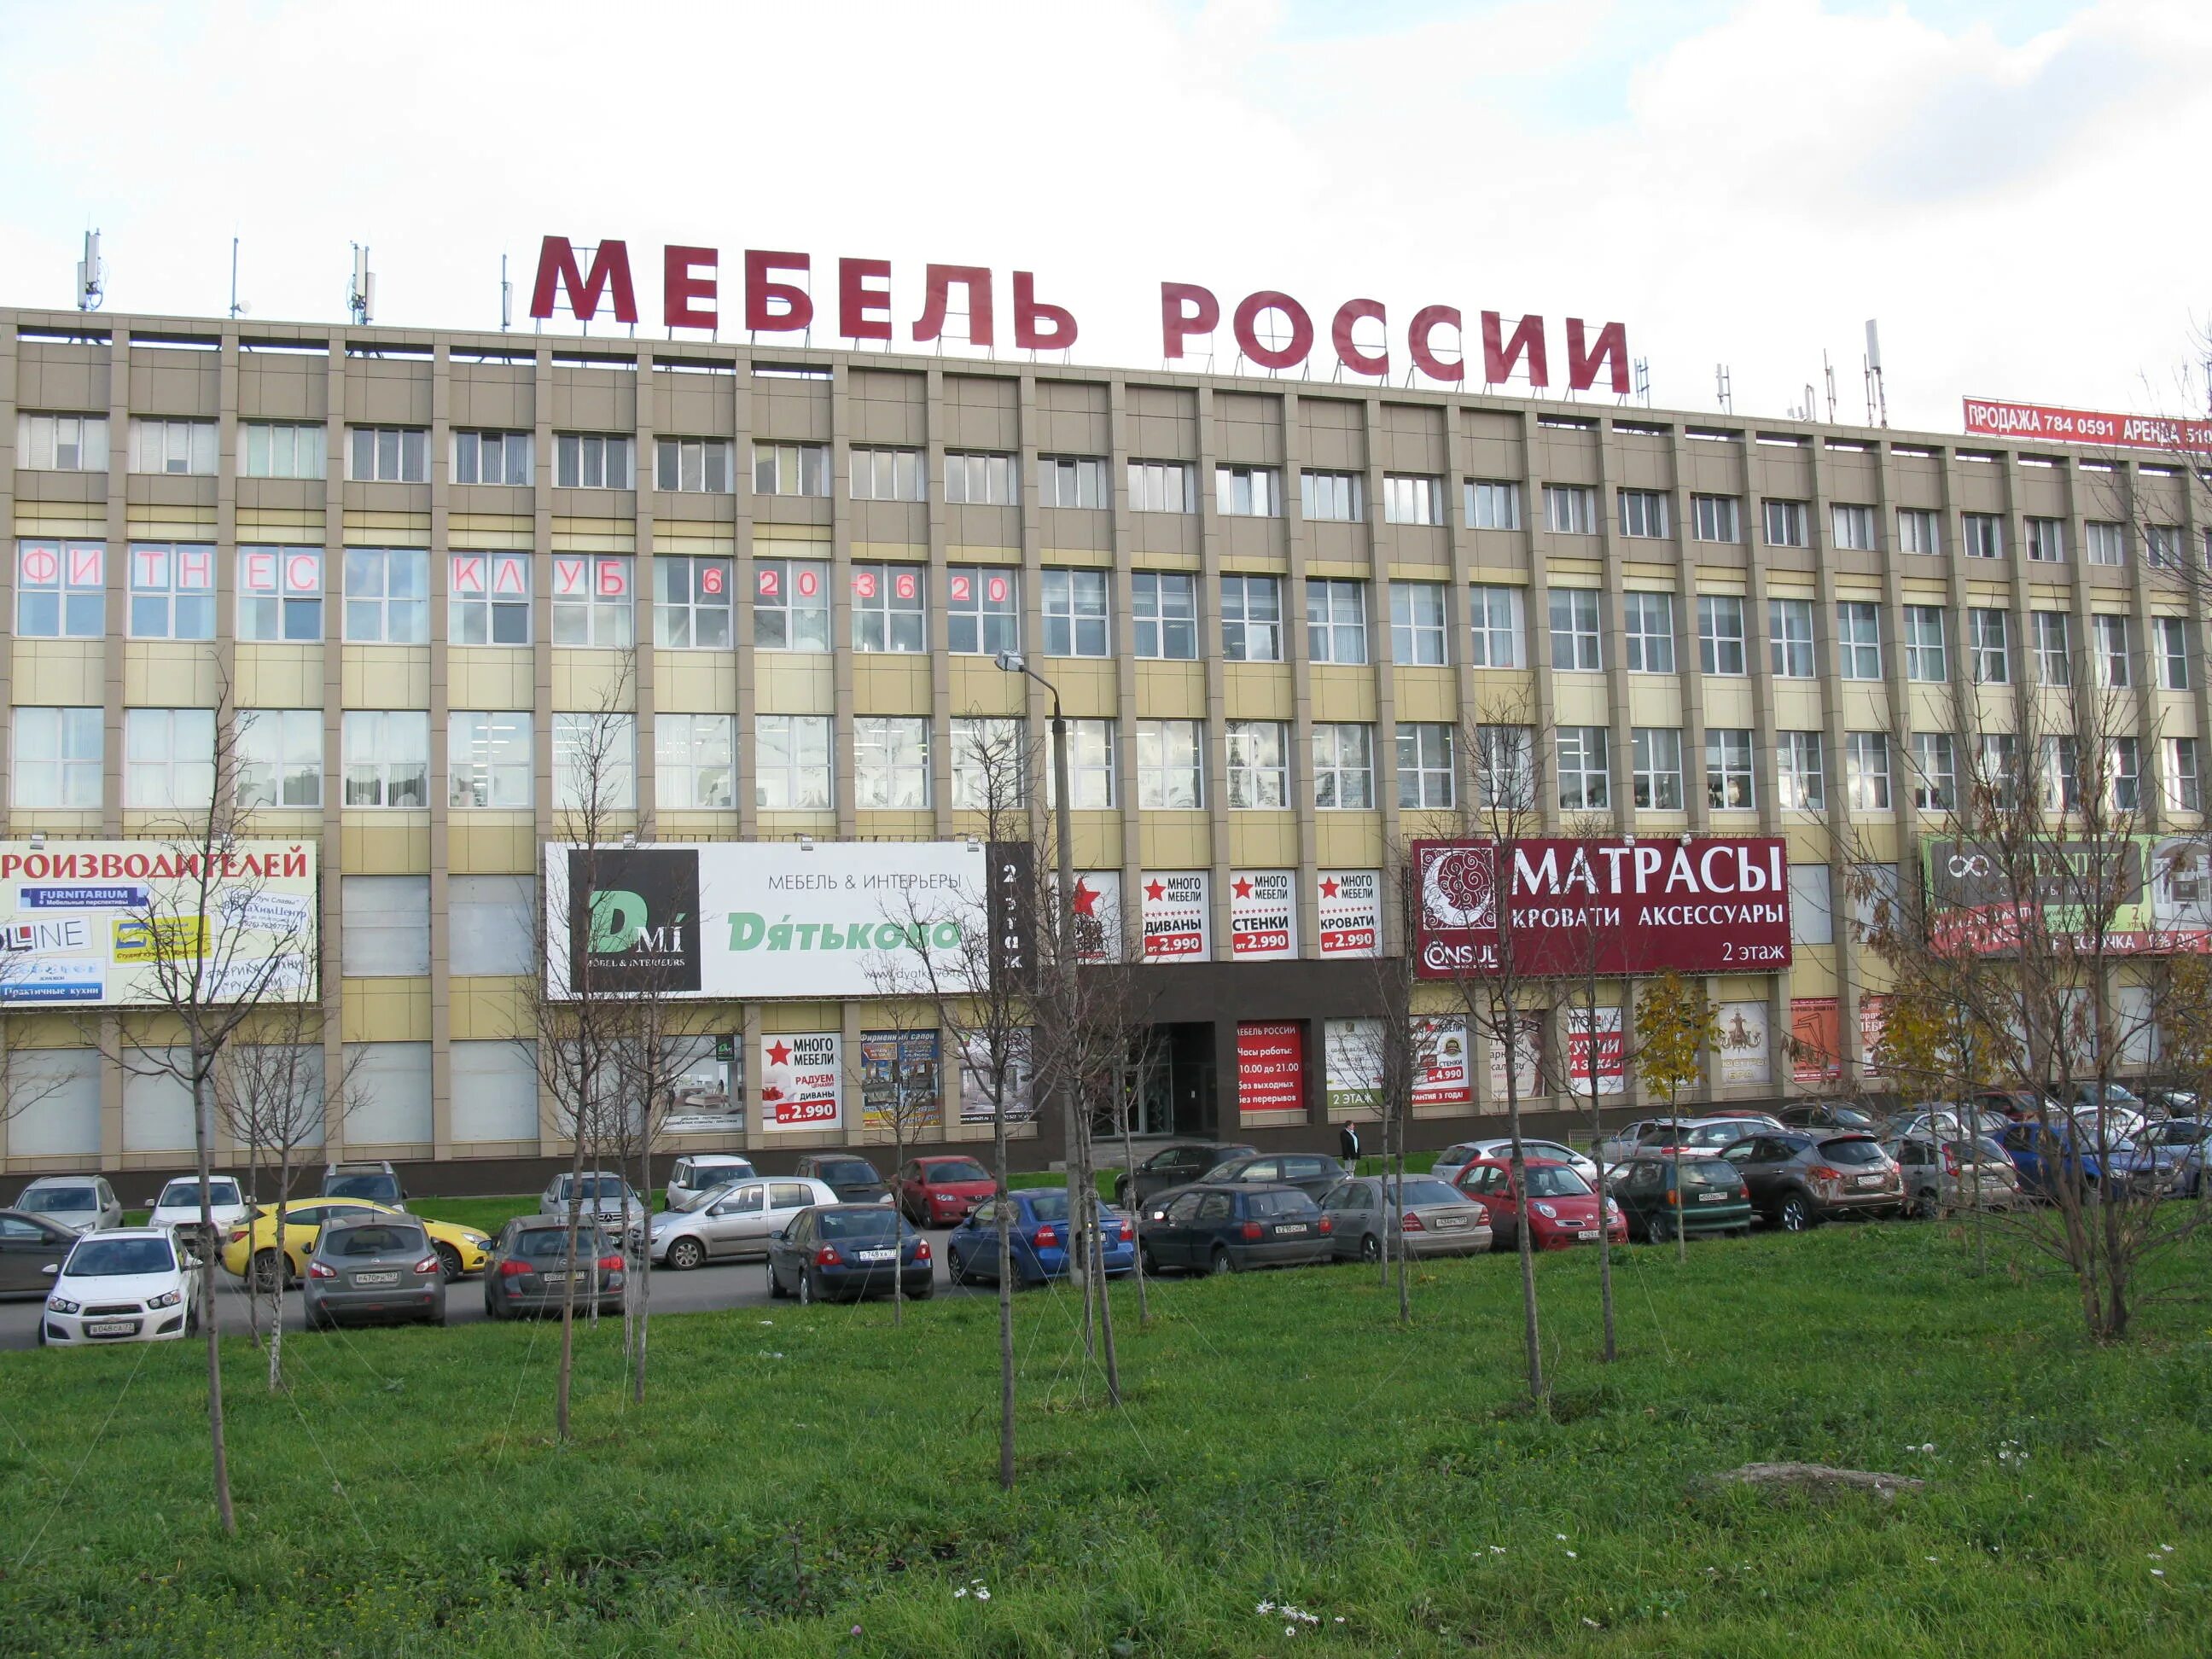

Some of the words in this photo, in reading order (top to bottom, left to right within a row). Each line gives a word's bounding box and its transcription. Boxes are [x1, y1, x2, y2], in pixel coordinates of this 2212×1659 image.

[530, 236, 1078, 350] МЕБЕЛЬ
[1161, 282, 1630, 394] РОССИИ
[1968, 405, 2040, 433] ПРОДАЖА
[2044, 415, 2074, 433] 784
[2077, 418, 2114, 436] 0591
[2123, 419, 2180, 446] АРЕНДА
[23, 547, 318, 591] ФИТНЕС
[453, 557, 625, 596] КЛУБ
[1512, 846, 1782, 895] МАТРАСЫ
[768, 875, 838, 889] МЕБЕЛЬ
[844, 874, 857, 889] &
[864, 874, 961, 889] ИНТЕРЬЕРЫ
[1167, 877, 1202, 890] МНОГО
[1254, 876, 1288, 888] МНОГО
[1341, 875, 1372, 888] МНОГО
[40, 891, 128, 899] FURNITARIUM
[1167, 891, 1202, 902] МЕБЕЛИ
[1254, 888, 1288, 899] МЕБЕЛИ
[1342, 888, 1373, 899] МЕБЕЛИ
[1512, 907, 1621, 928] КРОВАТИ
[1639, 904, 1784, 927] АКСЕССУАРЫ
[1144, 918, 1202, 935] ДИВАНЫ
[1232, 916, 1289, 931] СТЕНКИ
[1320, 916, 1375, 930] КРОВАТИ
[1159, 937, 1200, 952] 2.990
[1247, 934, 1287, 948] 2.990
[1335, 933, 1372, 947] 2.990
[1722, 942, 1732, 961] 2
[1738, 943, 1785, 961] этаж
[3, 987, 66, 998] Практичные
[70, 987, 99, 997] кухни
[1264, 1026, 1296, 1035] РОССИИ
[794, 1038, 834, 1052] МНОГО
[1260, 1046, 1293, 1057] работы:
[794, 1053, 835, 1066] МЕБЕЛИ
[1439, 1059, 1463, 1068] СТЕНКИ
[1240, 1064, 1263, 1074] 10.00
[1276, 1063, 1299, 1073] 21.00
[1436, 1069, 1462, 1079] 4.990
[795, 1074, 835, 1086] РАДУЕМ
[1253, 1080, 1295, 1090] выходных
[800, 1091, 835, 1102] ДИВАНЫ
[1252, 1095, 1297, 1105] перерывов
[1333, 1093, 1340, 1104] 2
[1342, 1092, 1373, 1104] ЭТАЖ
[791, 1103, 834, 1119] 2.990
